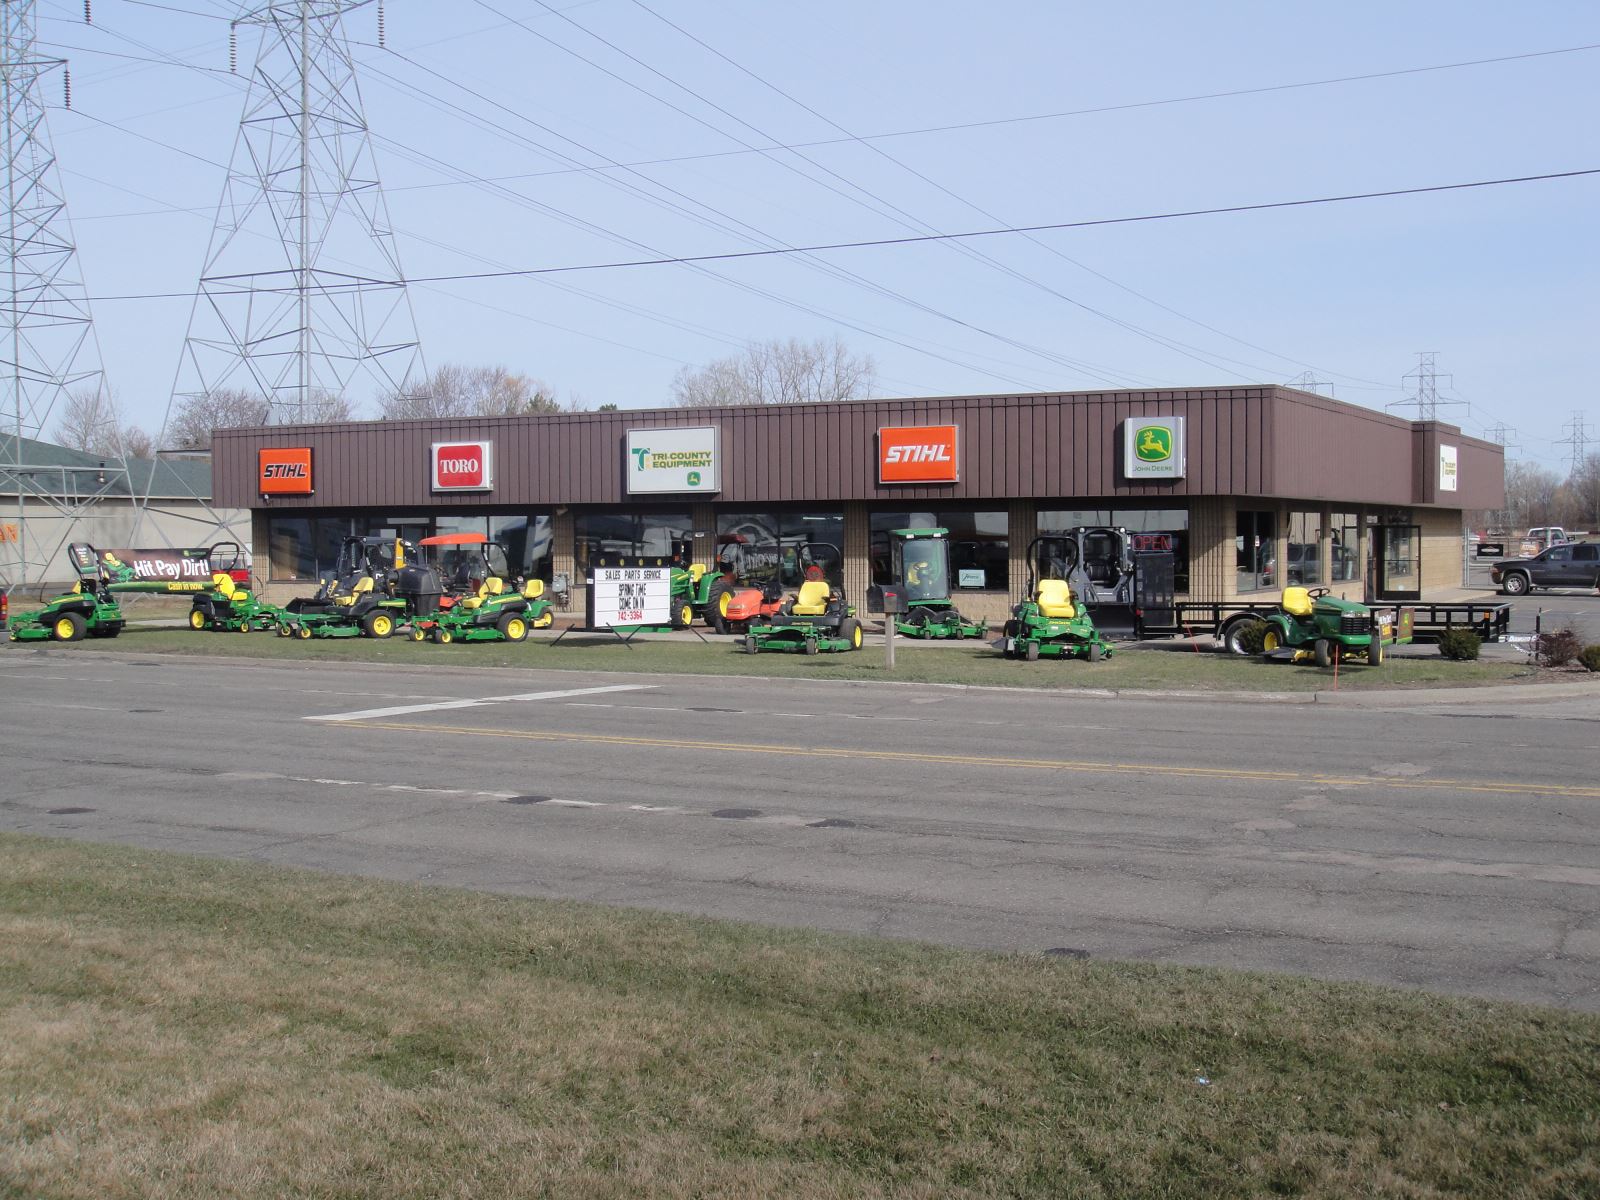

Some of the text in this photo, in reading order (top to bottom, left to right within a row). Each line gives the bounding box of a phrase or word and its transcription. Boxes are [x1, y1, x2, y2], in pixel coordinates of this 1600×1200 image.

[884, 444, 951, 463] STIHL
[263, 463, 307, 479] STIHL
[439, 458, 479, 474] TORO
[652, 460, 712, 469] EQUIPMENT
[1134, 535, 1171, 550] OPEN
[133, 559, 210, 580] Hit Pay Dirt!
[605, 570, 661, 579] SALES PARTS SERVICE
[619, 597, 632, 610] COME
